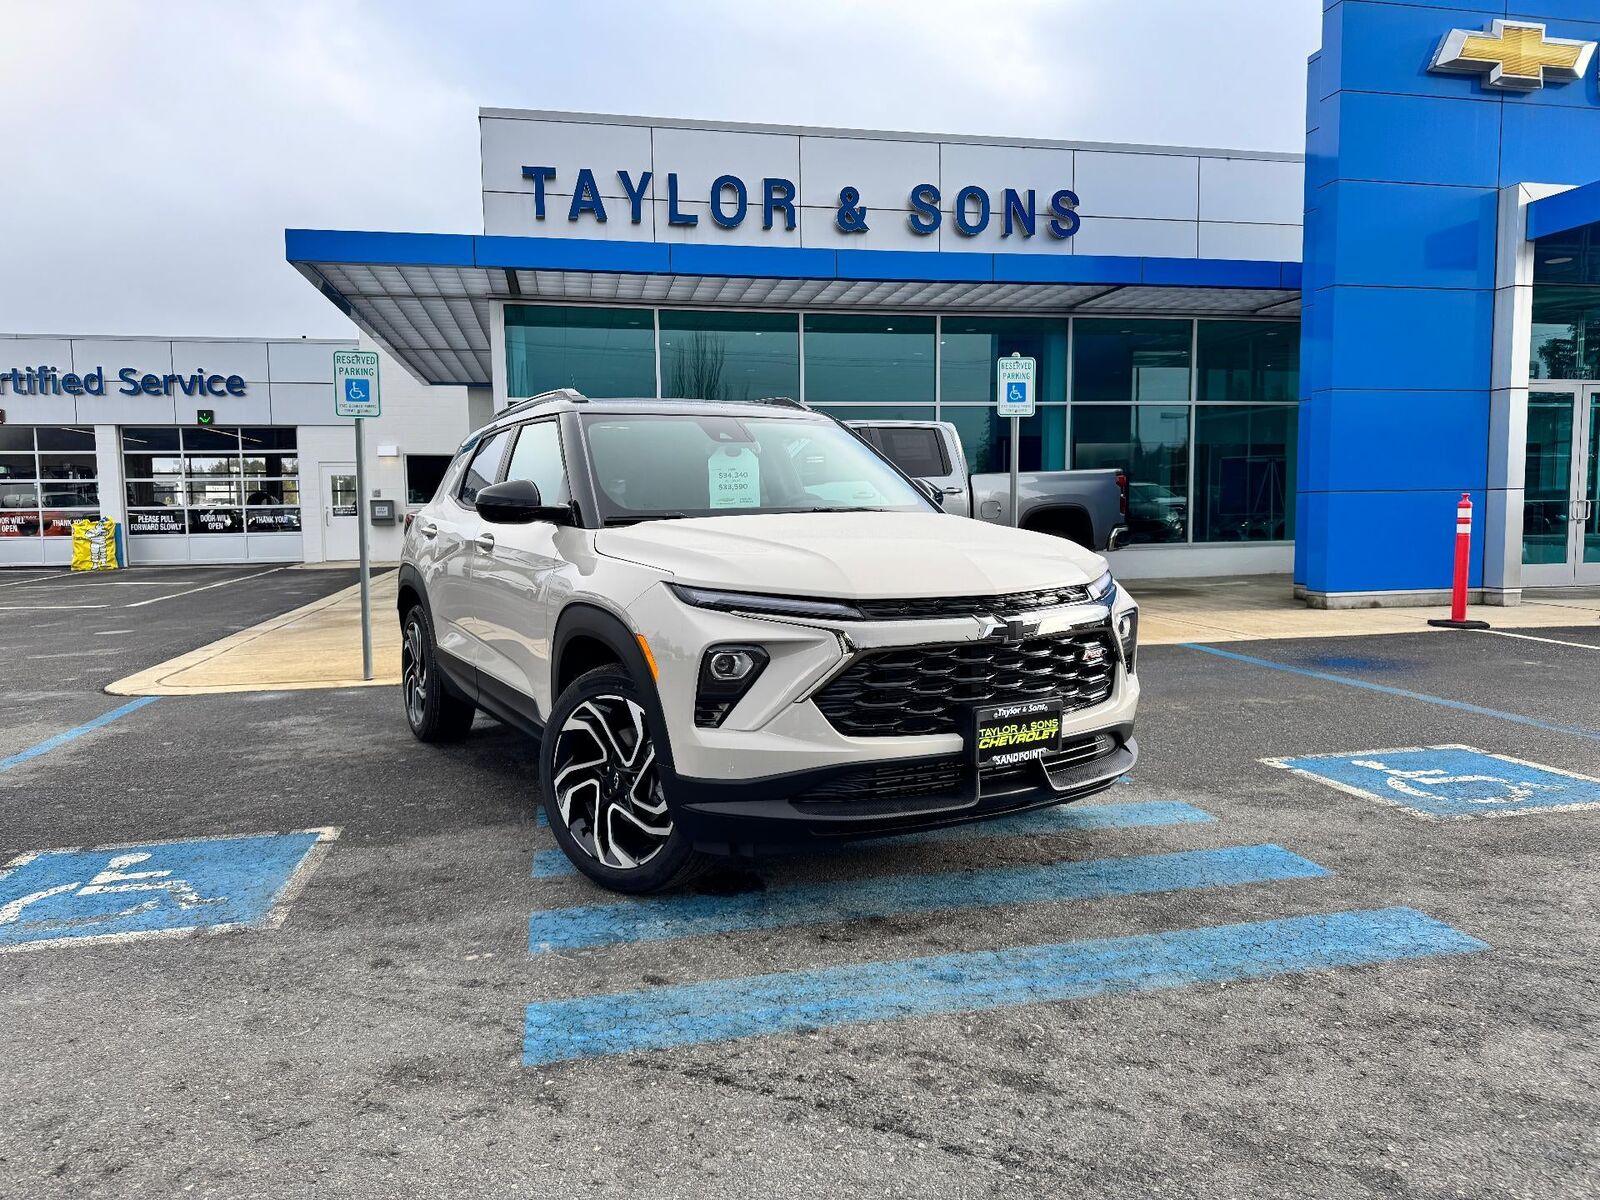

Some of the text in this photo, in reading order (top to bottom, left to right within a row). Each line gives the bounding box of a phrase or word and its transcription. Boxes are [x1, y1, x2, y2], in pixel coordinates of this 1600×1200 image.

[521, 166, 1081, 239] TAYLOR & SONS
[336, 355, 376, 365] RESERVED
[1001, 361, 1033, 370] RESERVED
[338, 367, 375, 376] PARKING
[1002, 372, 1031, 380] PARKING
[118, 367, 247, 397] Service
[11, 516, 26, 525] WILL
[137, 514, 175, 523] PLEASE PULL
[200, 514, 215, 522] DOOR
[256, 516, 274, 524] THANK
[52, 519, 72, 527] THANK
[130, 523, 182, 531] FORWARD SLOWLY
[208, 522, 224, 530] OPEN
[1, 524, 18, 532] OPEN
[997, 707, 1021, 718] Taylor
[1028, 704, 1046, 712] Sons
[979, 718, 1059, 737] TAYLOR & SONS
[978, 727, 1059, 749] CHEVROLET
[994, 749, 1042, 765] SANDPOINT
